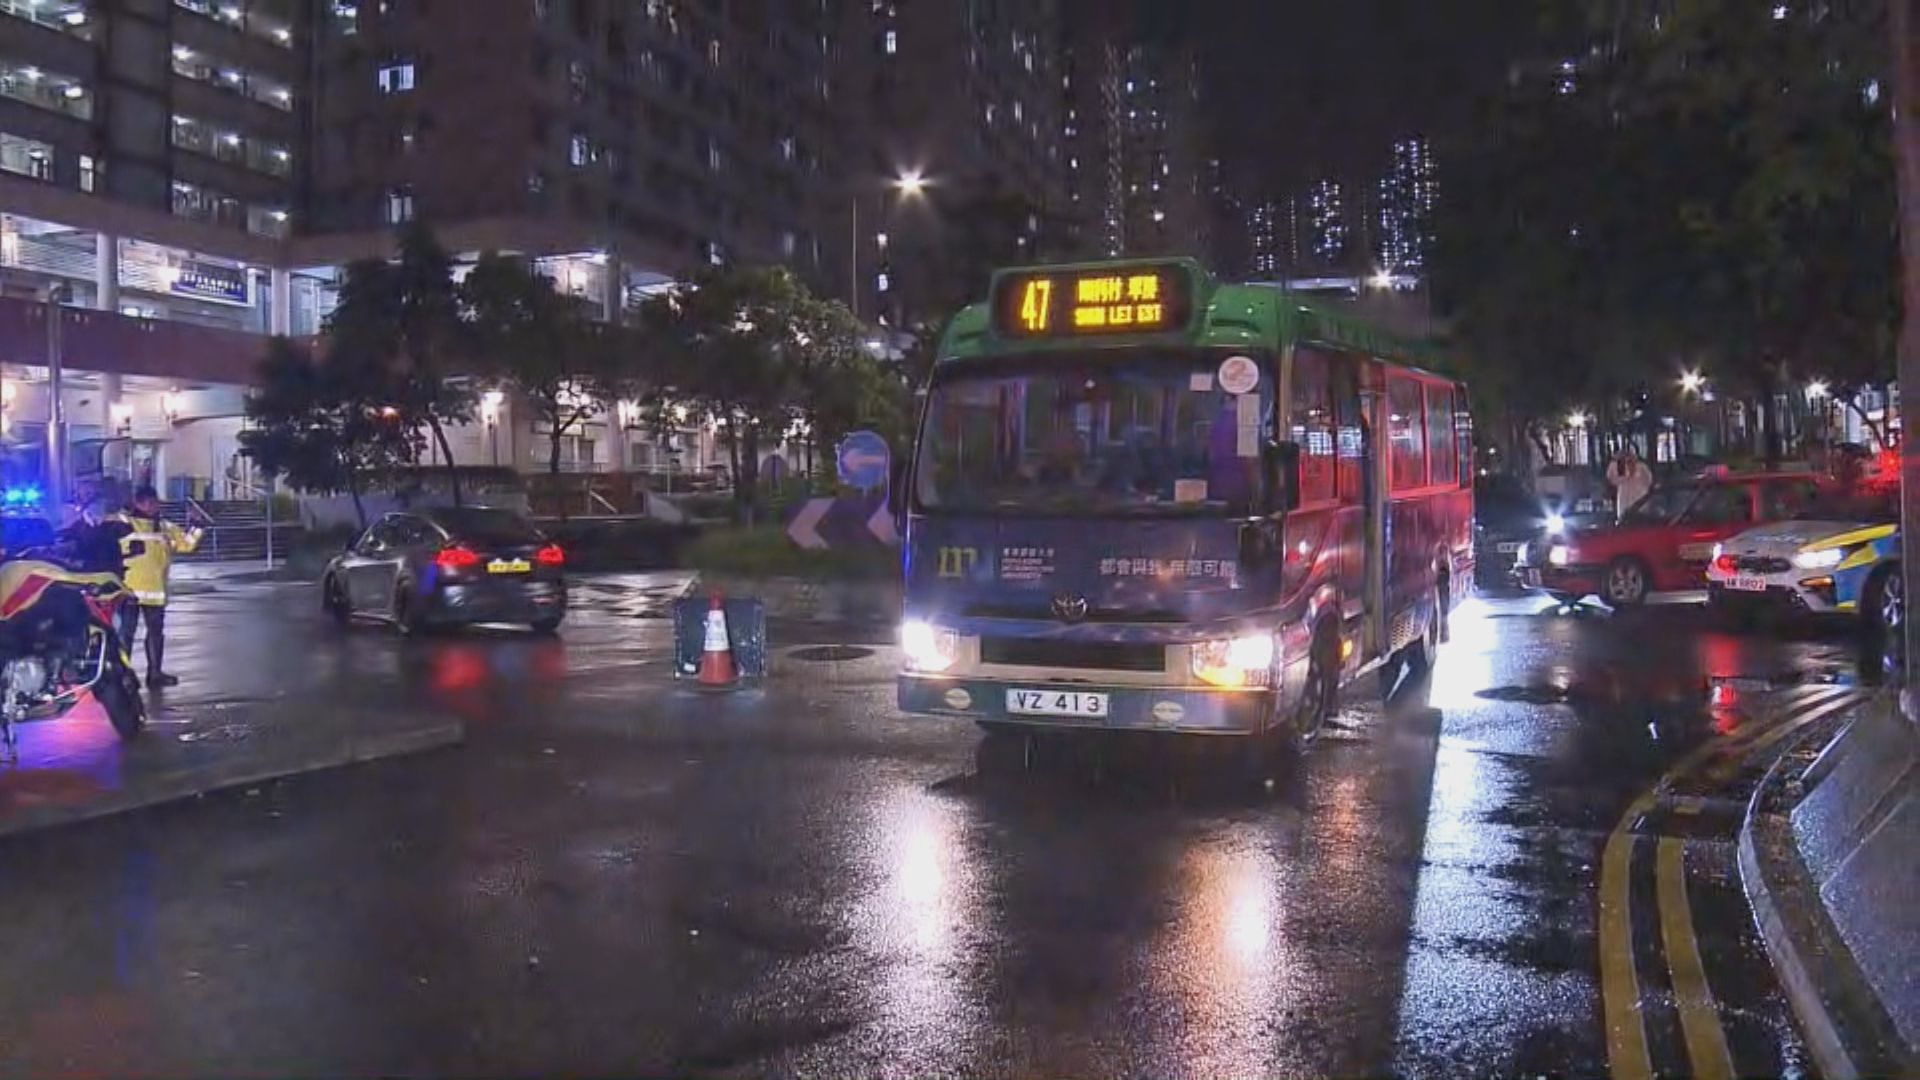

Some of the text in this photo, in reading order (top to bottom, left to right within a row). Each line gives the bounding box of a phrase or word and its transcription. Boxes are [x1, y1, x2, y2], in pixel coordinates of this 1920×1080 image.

[1021, 280, 1050, 330] 47
[1137, 304, 1161, 322] EST
[1017, 691, 1099, 712] VZ 413
